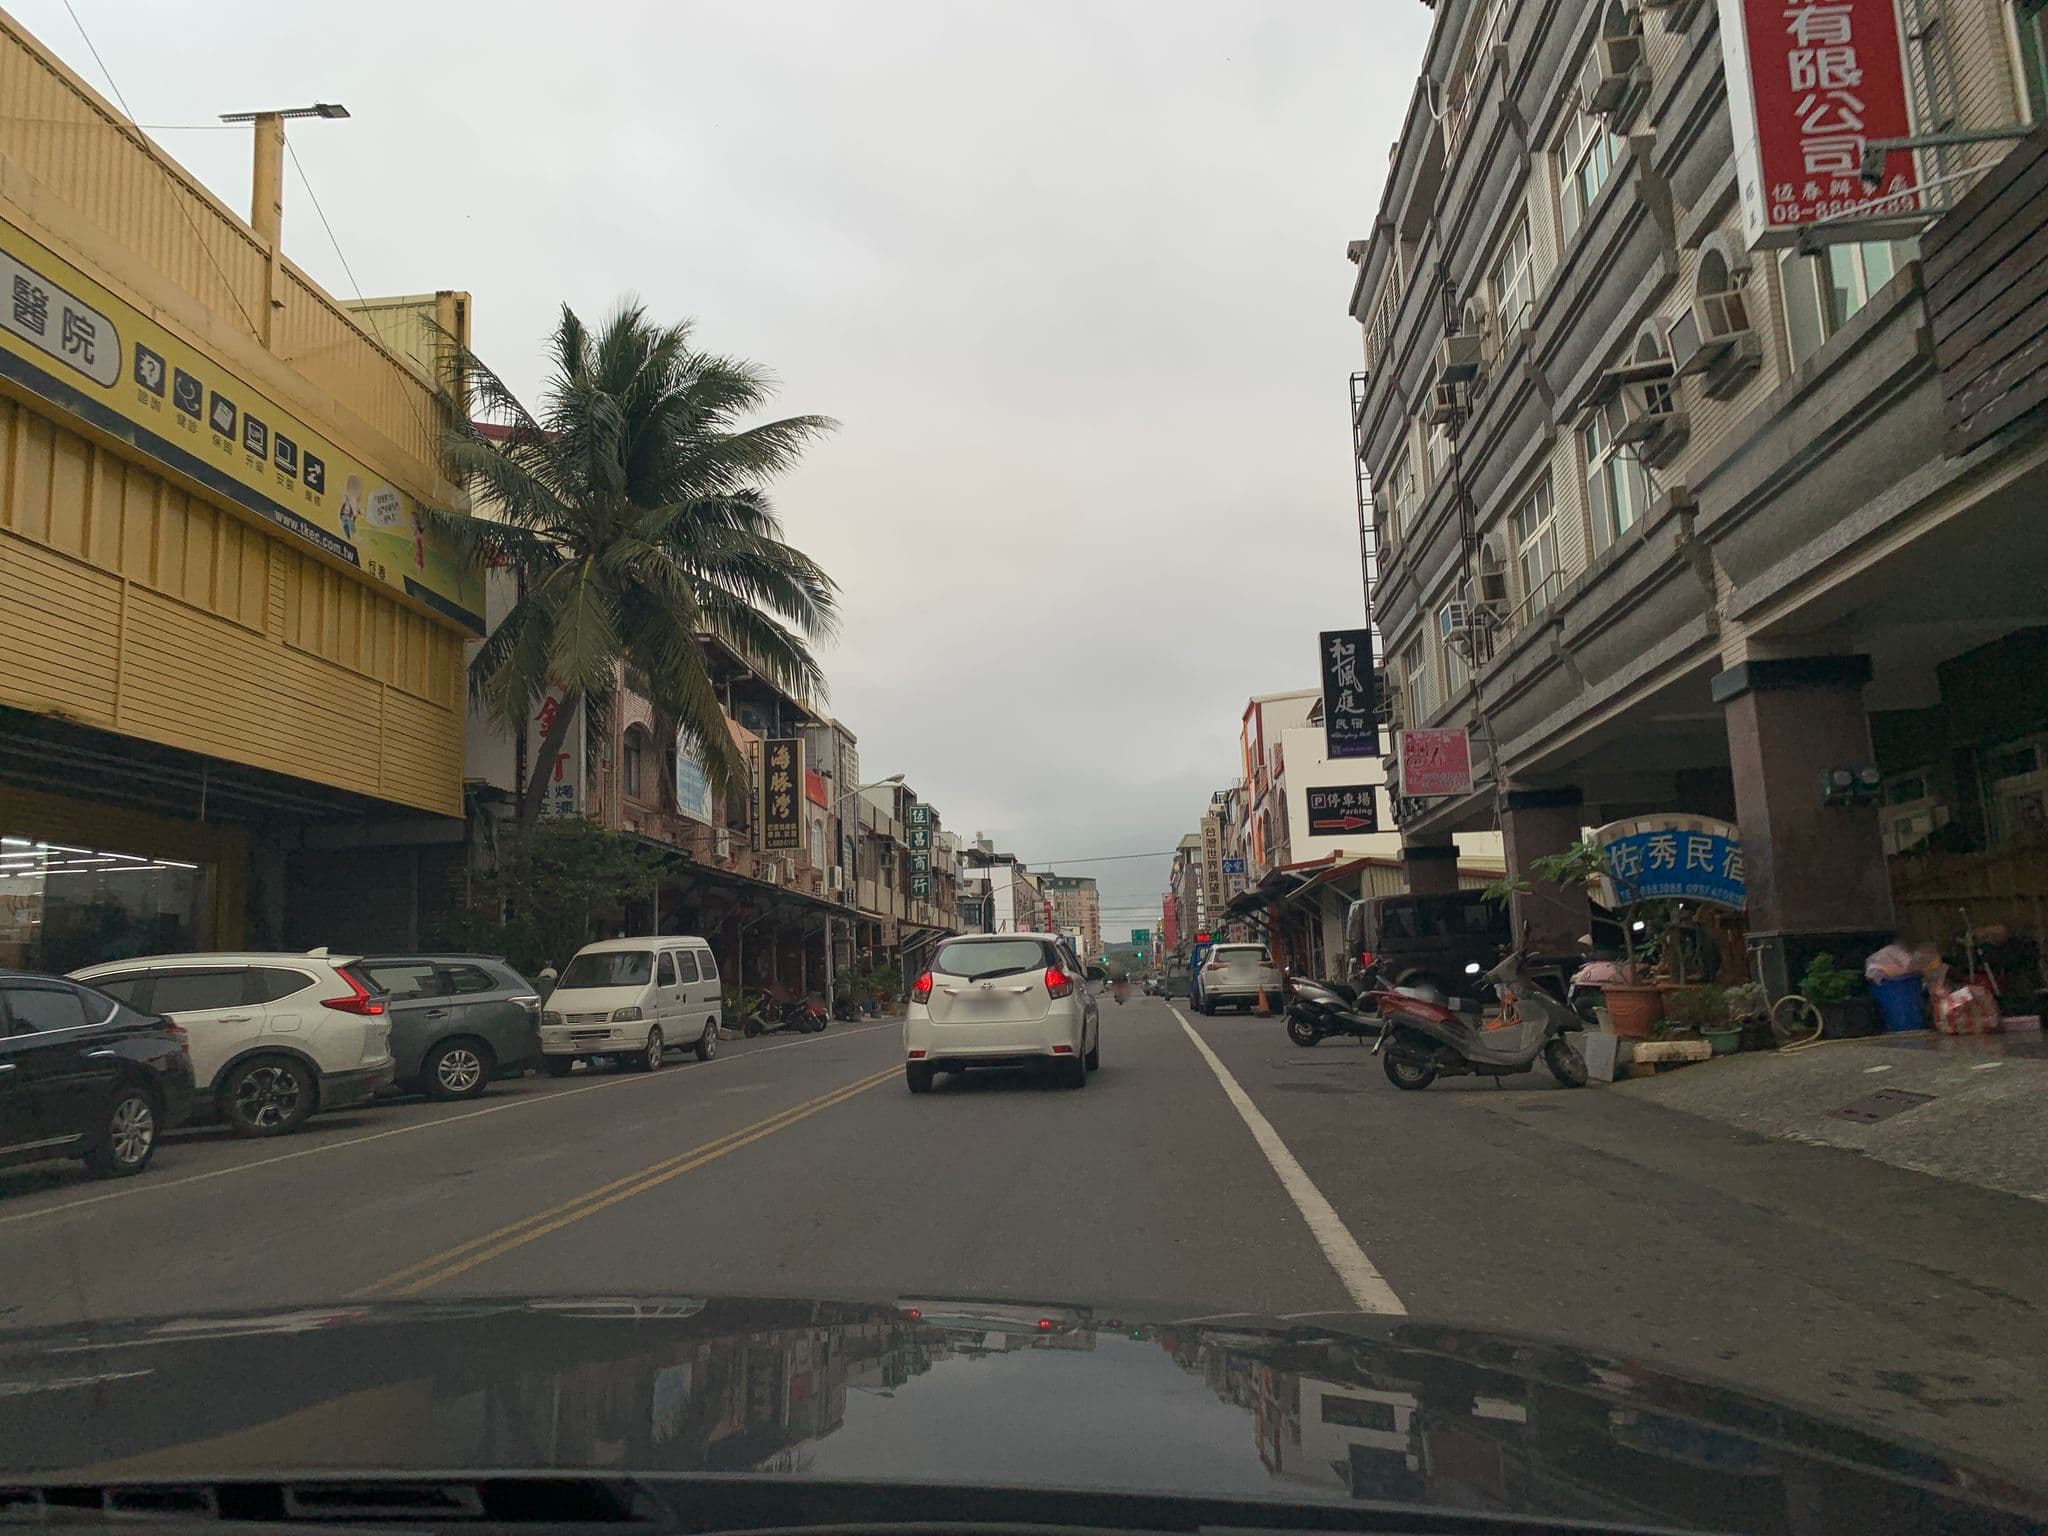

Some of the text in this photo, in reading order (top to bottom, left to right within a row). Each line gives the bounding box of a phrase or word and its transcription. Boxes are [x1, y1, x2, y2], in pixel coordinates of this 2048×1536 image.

[1783, 0, 1866, 178] 有限公司
[12, 274, 96, 366] 醫院
[274, 510, 355, 561] www.tkec.com.tw
[1329, 638, 1366, 714] 和風庭
[770, 744, 792, 819] 海豚灣
[1326, 792, 1371, 809] 停車場
[1340, 807, 1373, 816] Parking
[1205, 826, 1220, 905] 台灣世界展望會
